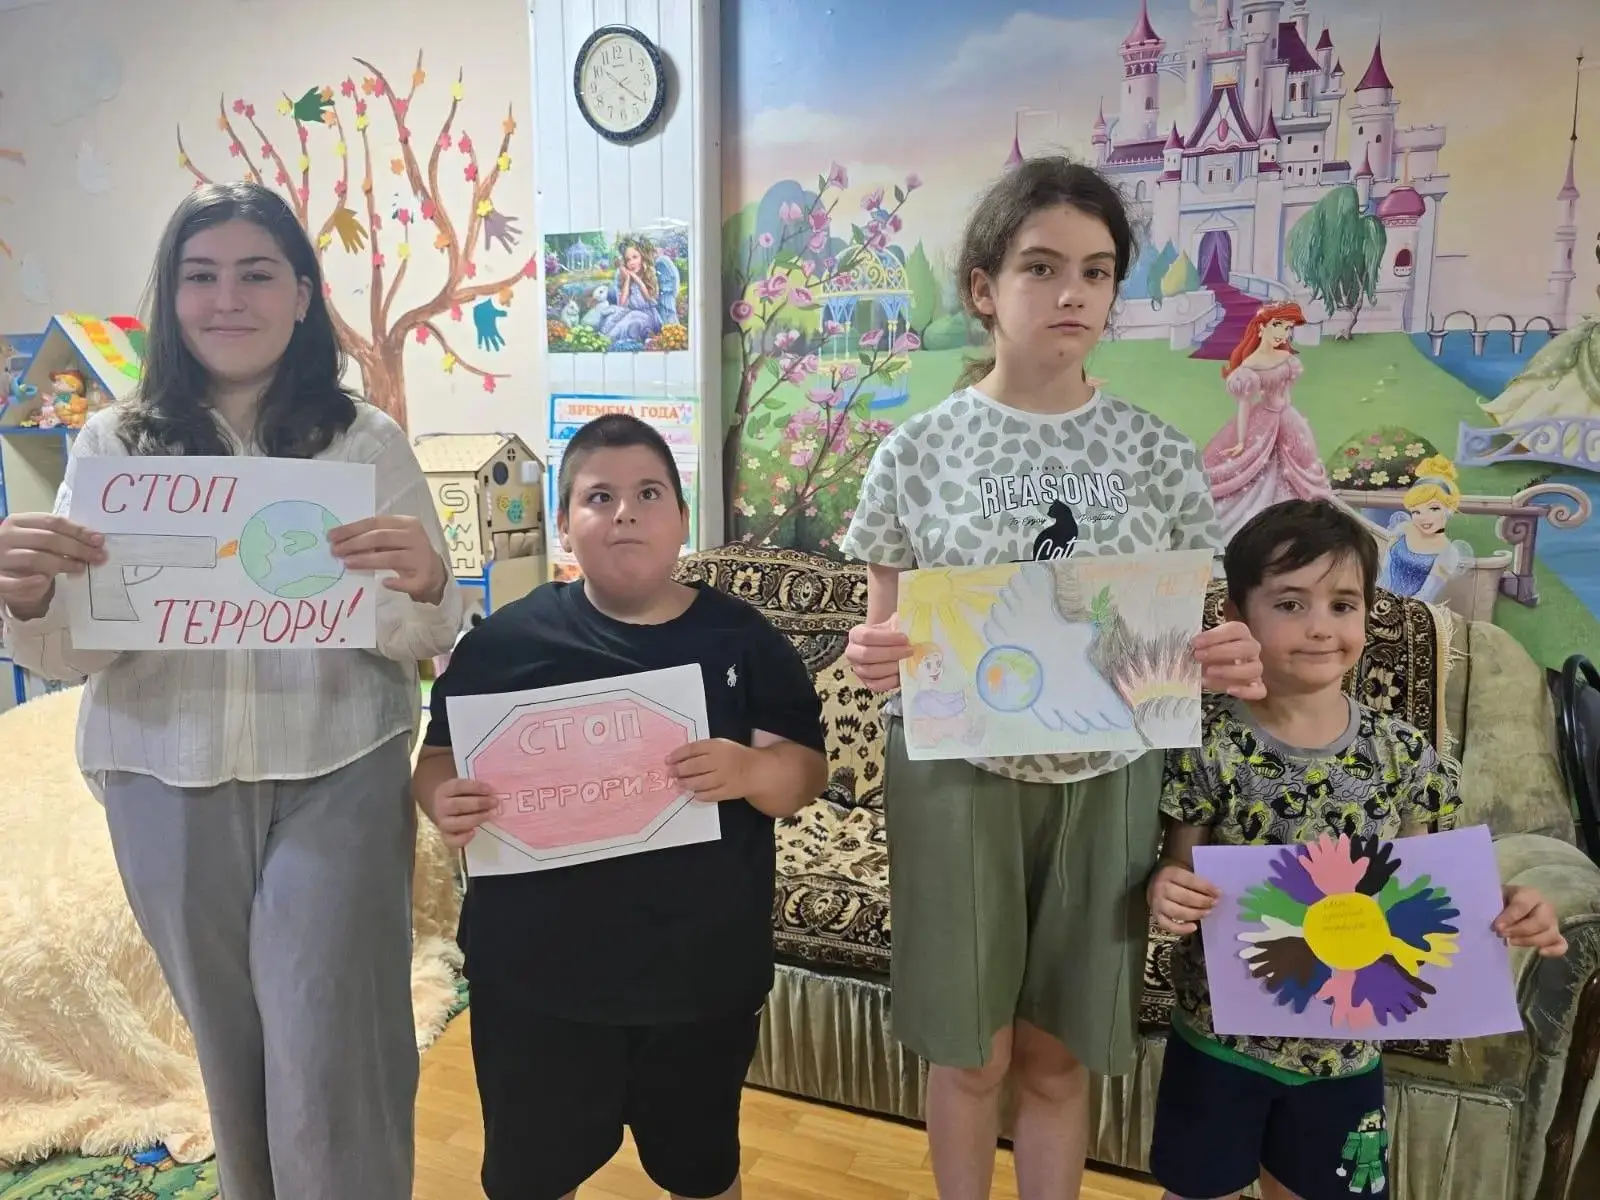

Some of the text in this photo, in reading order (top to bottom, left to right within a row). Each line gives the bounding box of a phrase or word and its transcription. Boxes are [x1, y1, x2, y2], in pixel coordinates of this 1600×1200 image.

[601, 50, 609, 65] 11
[612, 45, 622, 60] 12
[593, 65, 603, 78] 10
[640, 406, 679, 419] ГОДА
[101, 473, 238, 513] СТОП
[979, 473, 1129, 519] REASONS
[1035, 536, 1089, 561] Cat
[153, 587, 364, 644] ТЕРРОРУ!
[518, 707, 643, 756] СТОП
